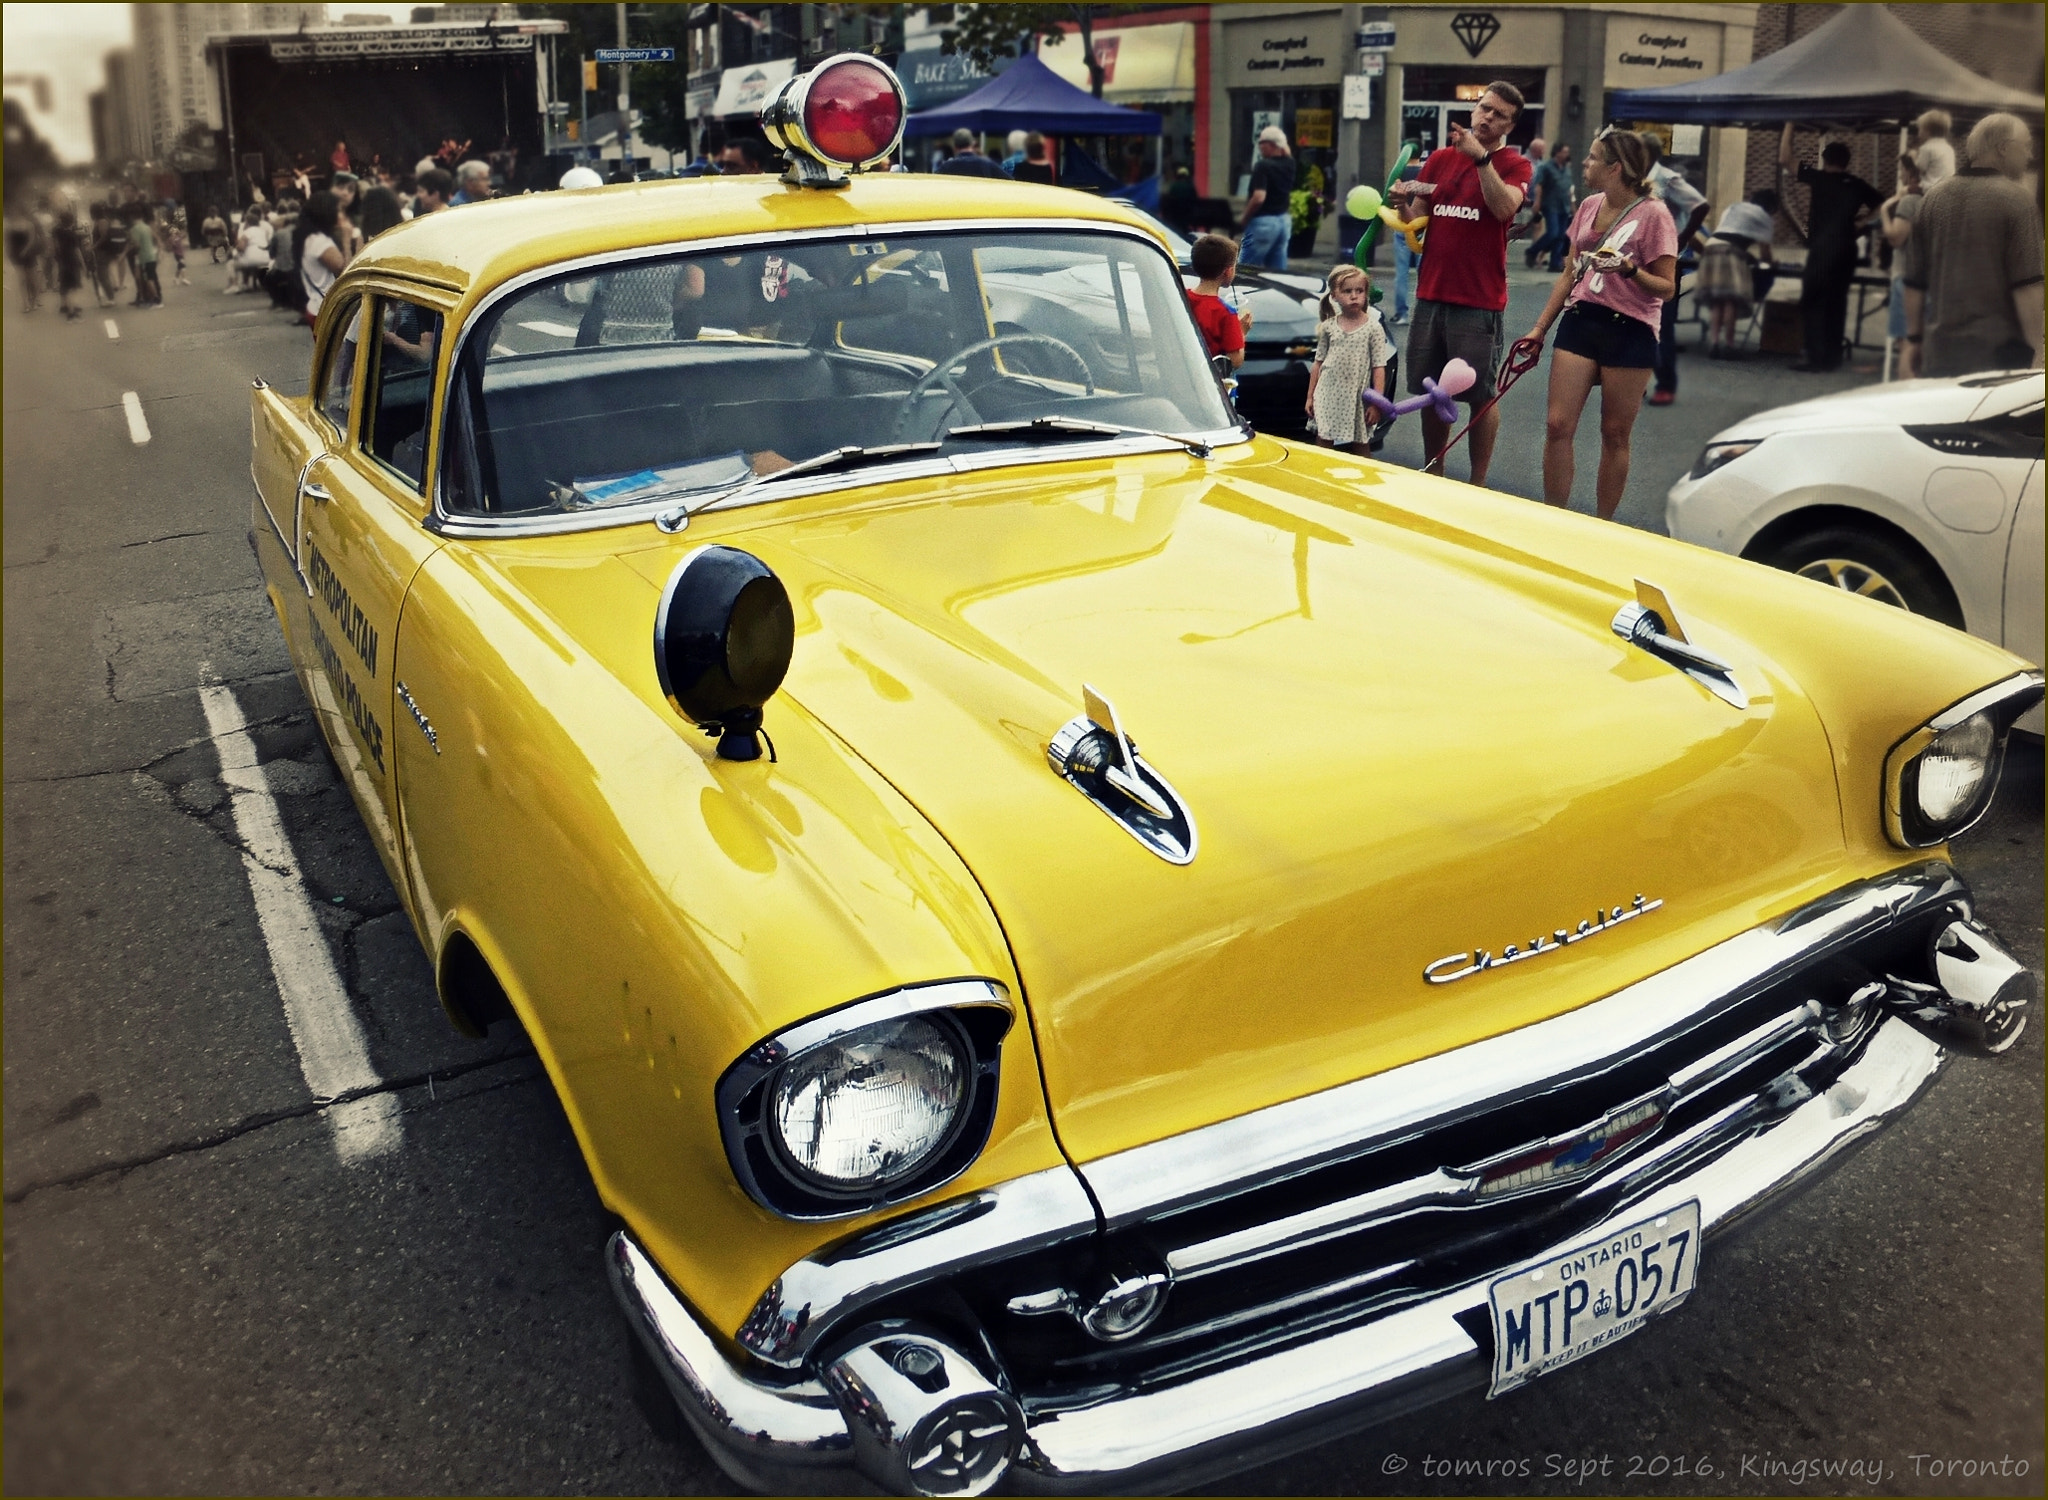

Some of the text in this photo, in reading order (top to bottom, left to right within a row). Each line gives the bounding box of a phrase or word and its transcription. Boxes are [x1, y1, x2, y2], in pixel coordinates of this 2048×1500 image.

[600, 49, 650, 61] Montgomery
[1657, 55, 1703, 70] Jewellers
[914, 63, 947, 84] BAKE
[1404, 106, 1437, 118] 3072
[1433, 203, 1480, 221] CANADA
[310, 541, 379, 679] METROPOLITAN
[345, 670, 386, 777] POLICE
[1422, 893, 1663, 984] Chevrolet
[1560, 1232, 1643, 1281] ONTARIO
[1505, 1229, 1691, 1372] MTP 057
[1542, 1348, 1574, 1370] KEEP
[1577, 1341, 1588, 1354] IT
